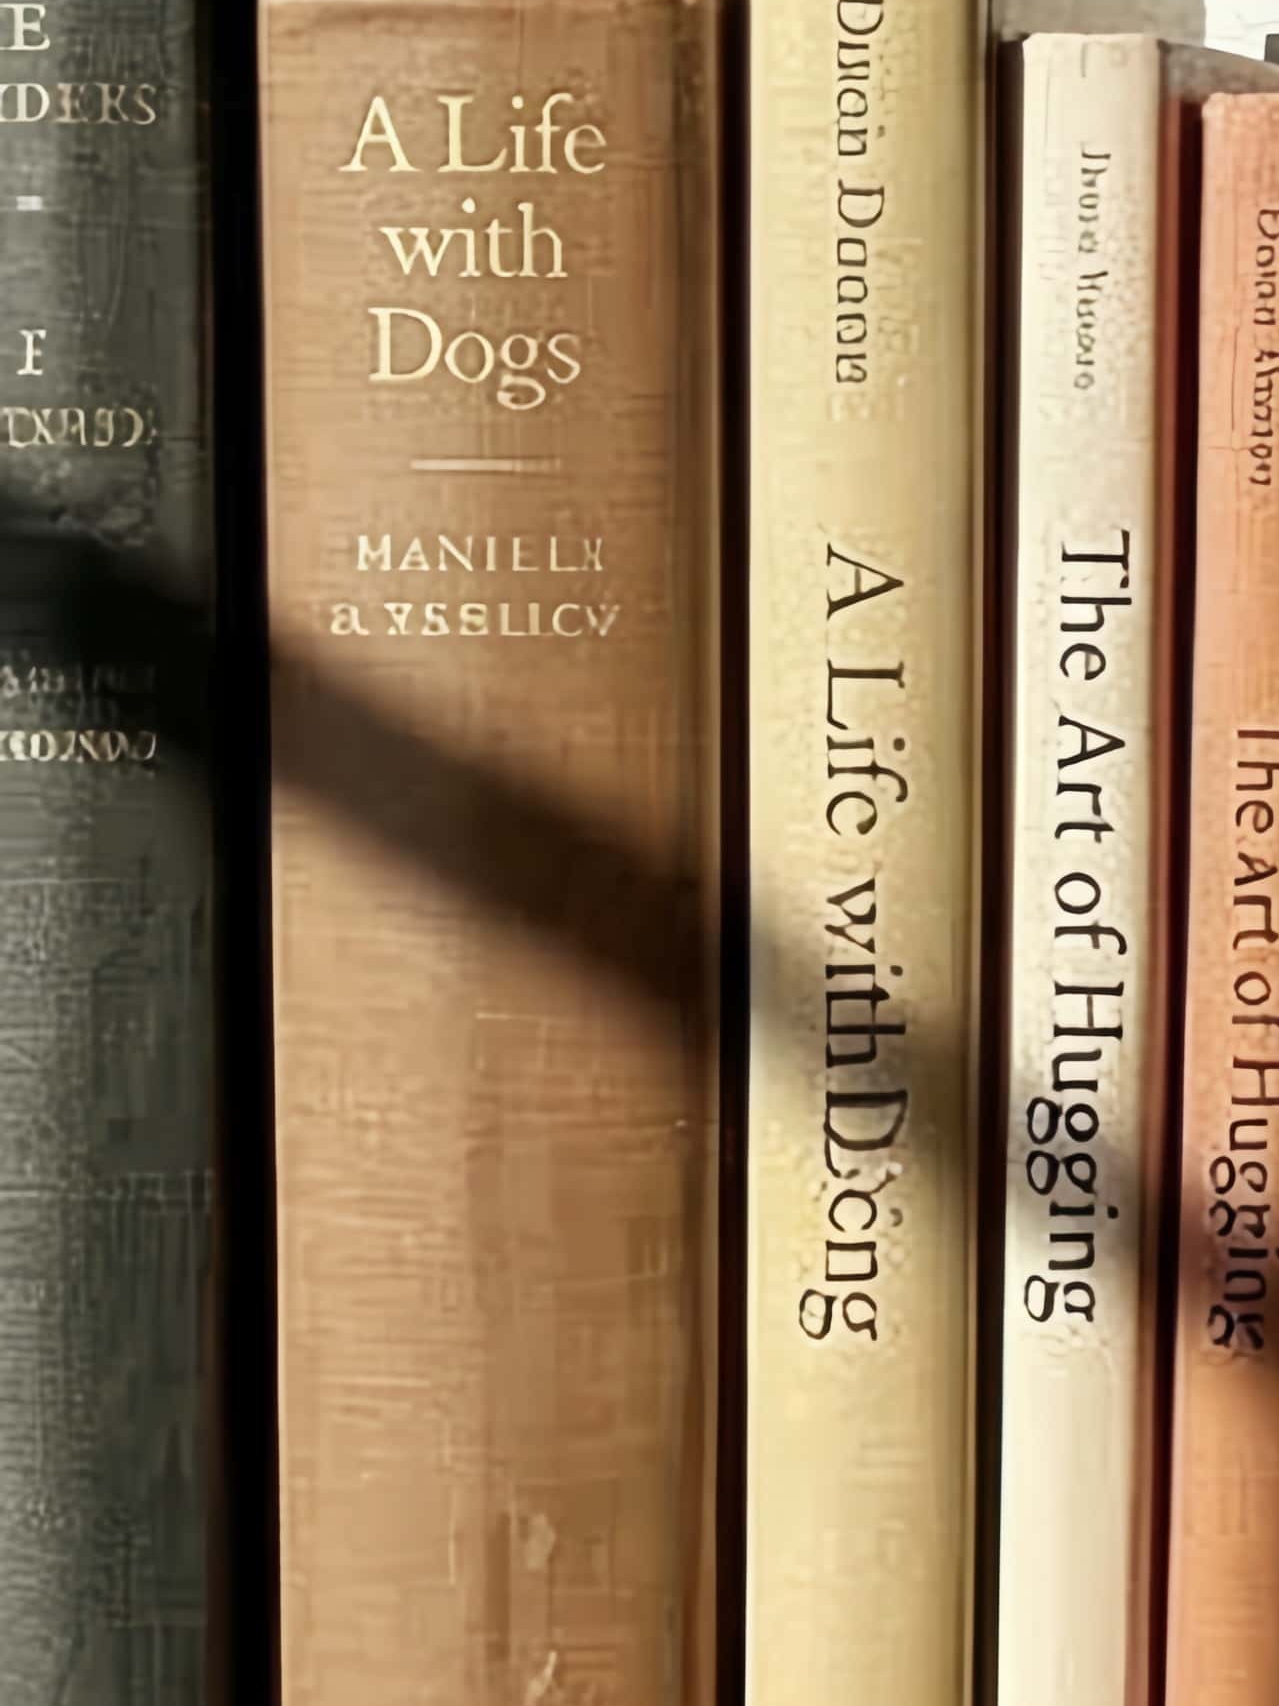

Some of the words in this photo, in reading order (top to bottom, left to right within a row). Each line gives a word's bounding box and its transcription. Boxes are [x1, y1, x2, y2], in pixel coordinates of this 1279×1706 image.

[339, 94, 420, 173] A
[437, 92, 608, 174] Life
[380, 197, 568, 278] with
[367, 306, 581, 410] Dogs
[825, 543, 906, 621] A
[1059, 528, 1132, 683] The
[1054, 714, 1127, 842] Art
[1054, 871, 1128, 957] of
[825, 876, 907, 1070] with
[1023, 979, 1126, 1324] Hugging
